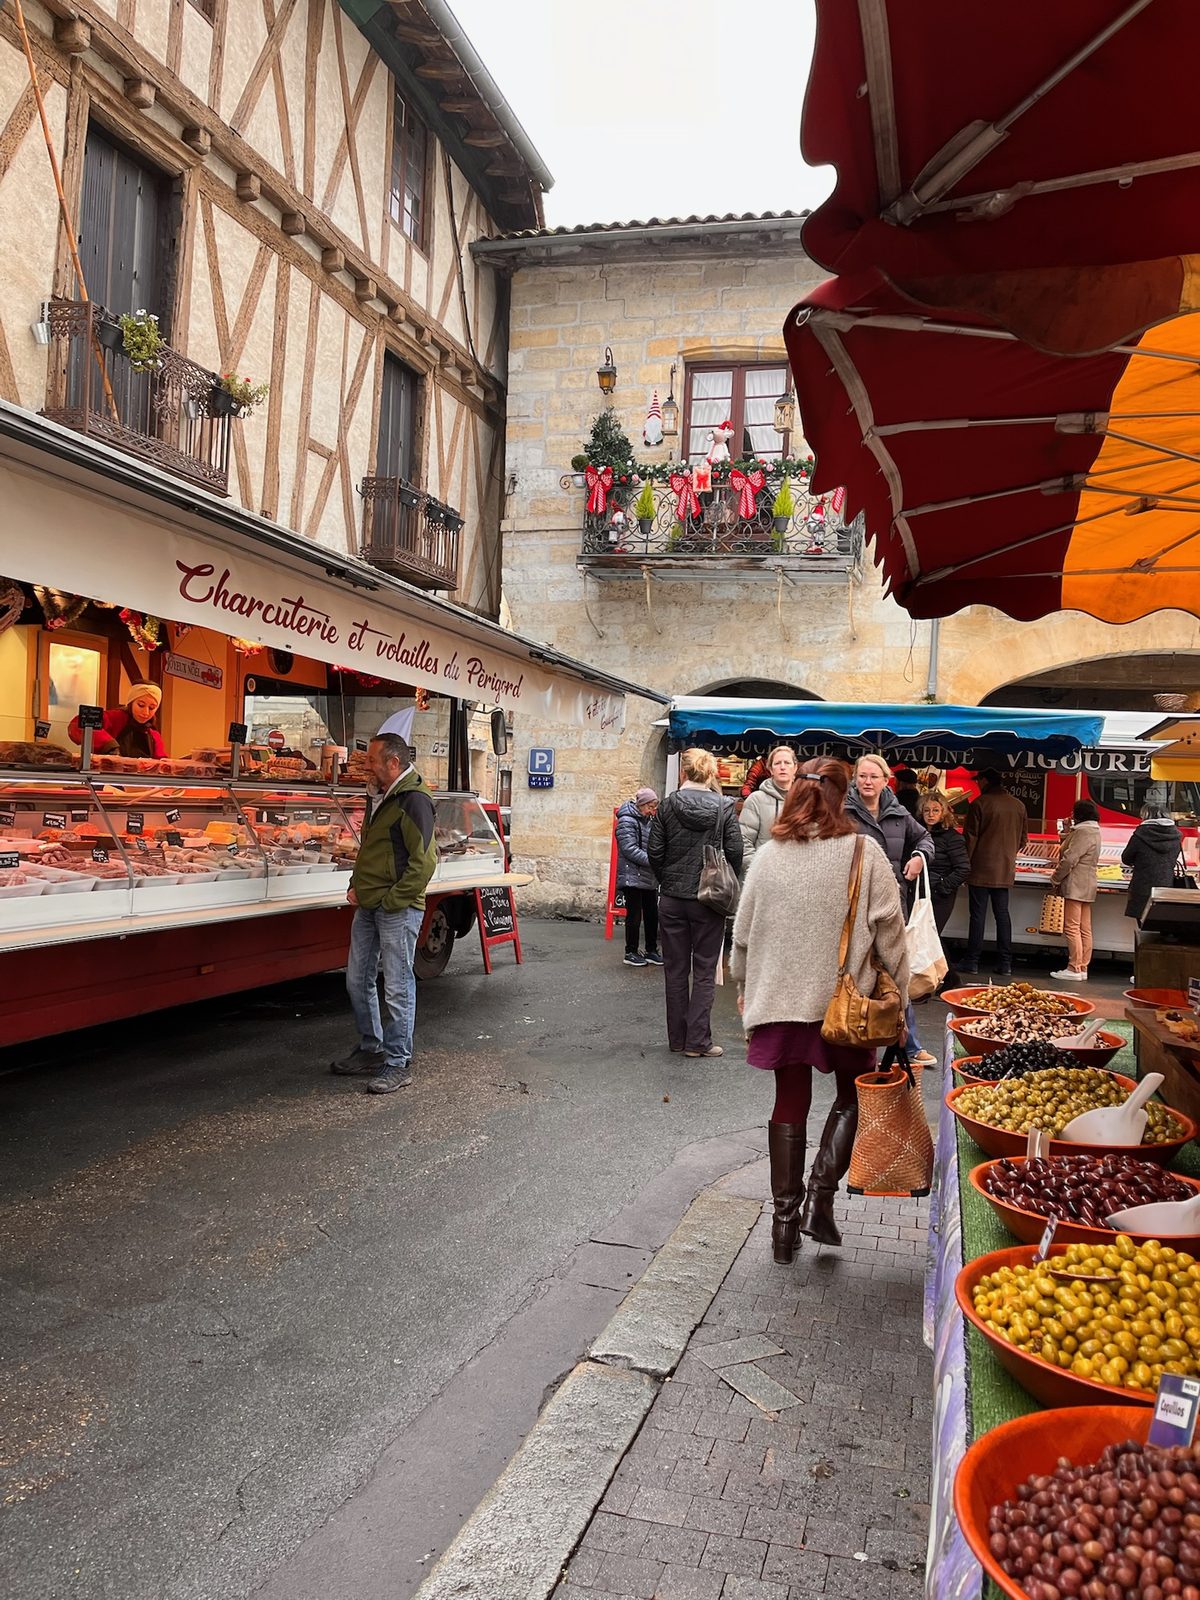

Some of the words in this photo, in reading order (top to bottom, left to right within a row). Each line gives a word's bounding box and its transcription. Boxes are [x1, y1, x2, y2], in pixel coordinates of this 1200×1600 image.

[175, 559, 339, 644] Charcuterie
[347, 619, 392, 651] et
[376, 632, 439, 675] volailles
[443, 651, 461, 681] du
[535, 752, 548, 769] P
